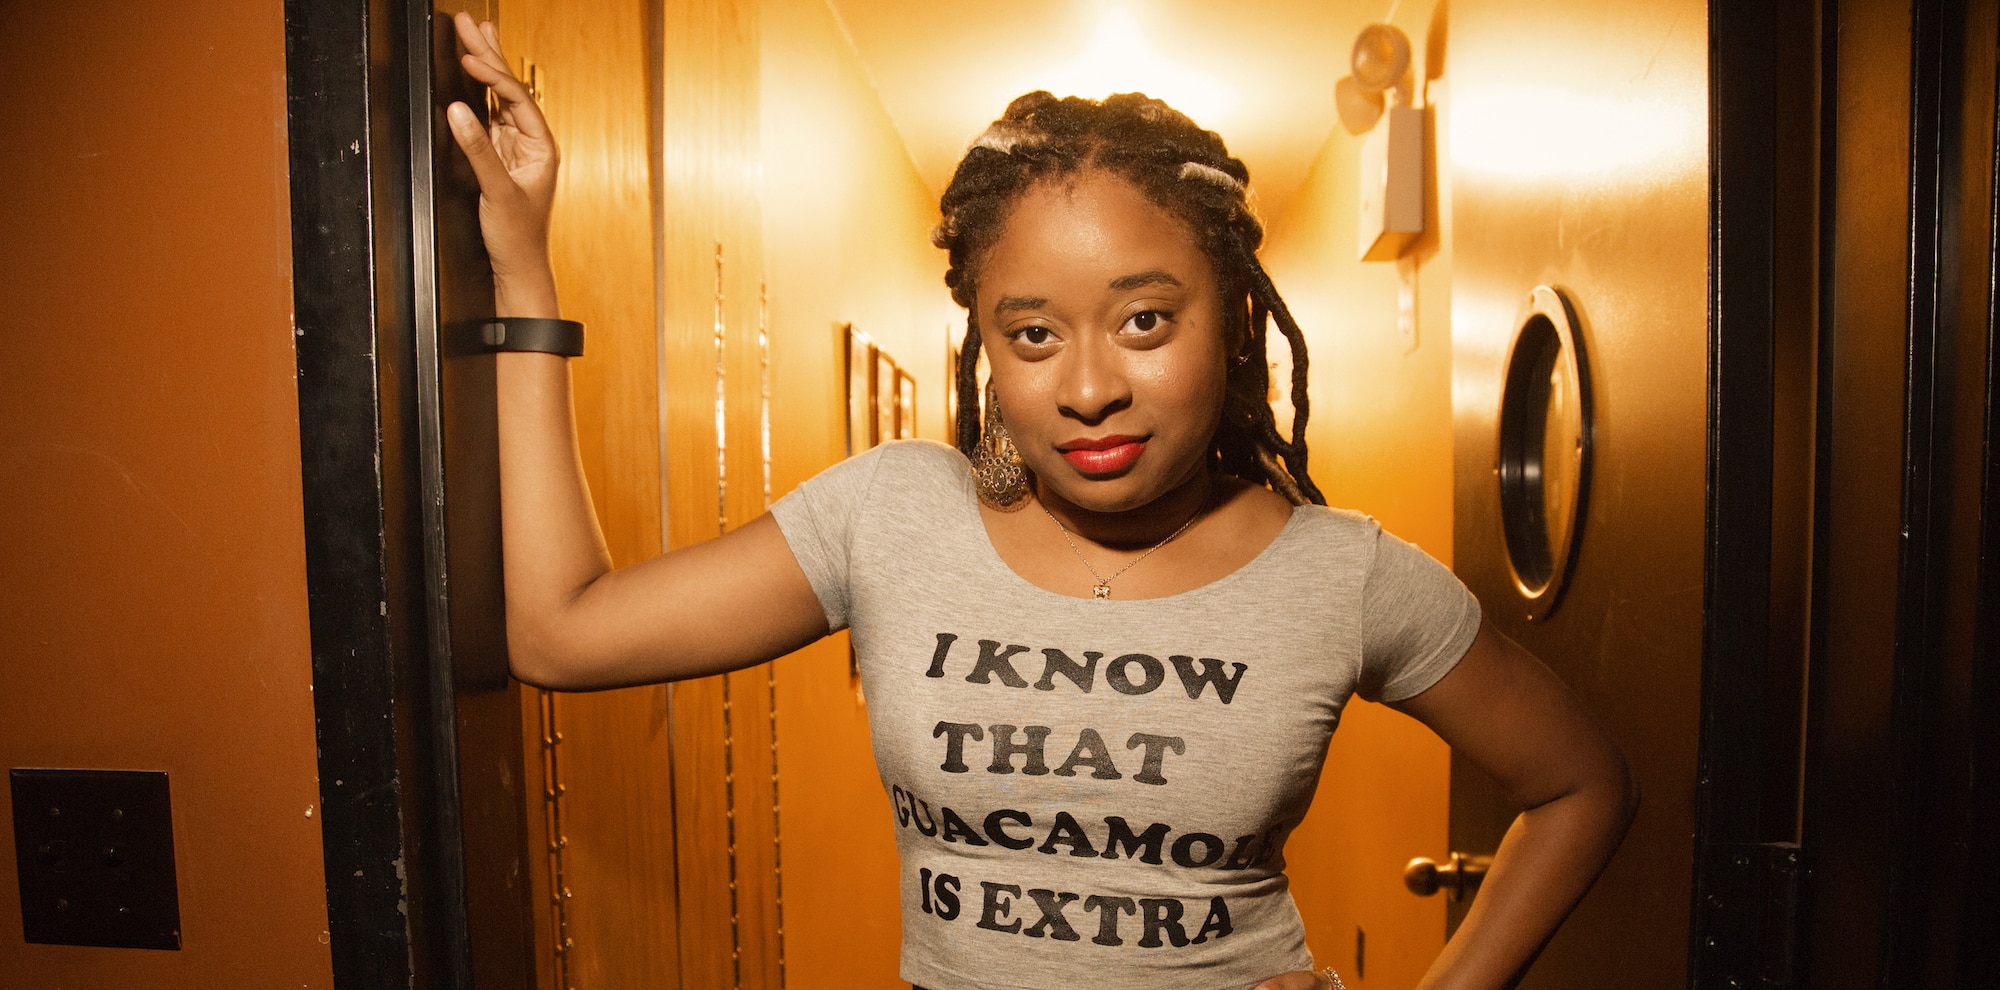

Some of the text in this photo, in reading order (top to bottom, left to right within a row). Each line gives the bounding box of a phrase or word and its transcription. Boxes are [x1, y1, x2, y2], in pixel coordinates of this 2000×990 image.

[926, 633, 1248, 704] I KNOW
[932, 721, 1185, 785] THAT
[893, 784, 1285, 870] GUACAMOLE
[920, 868, 1234, 948] IS EXTRA
